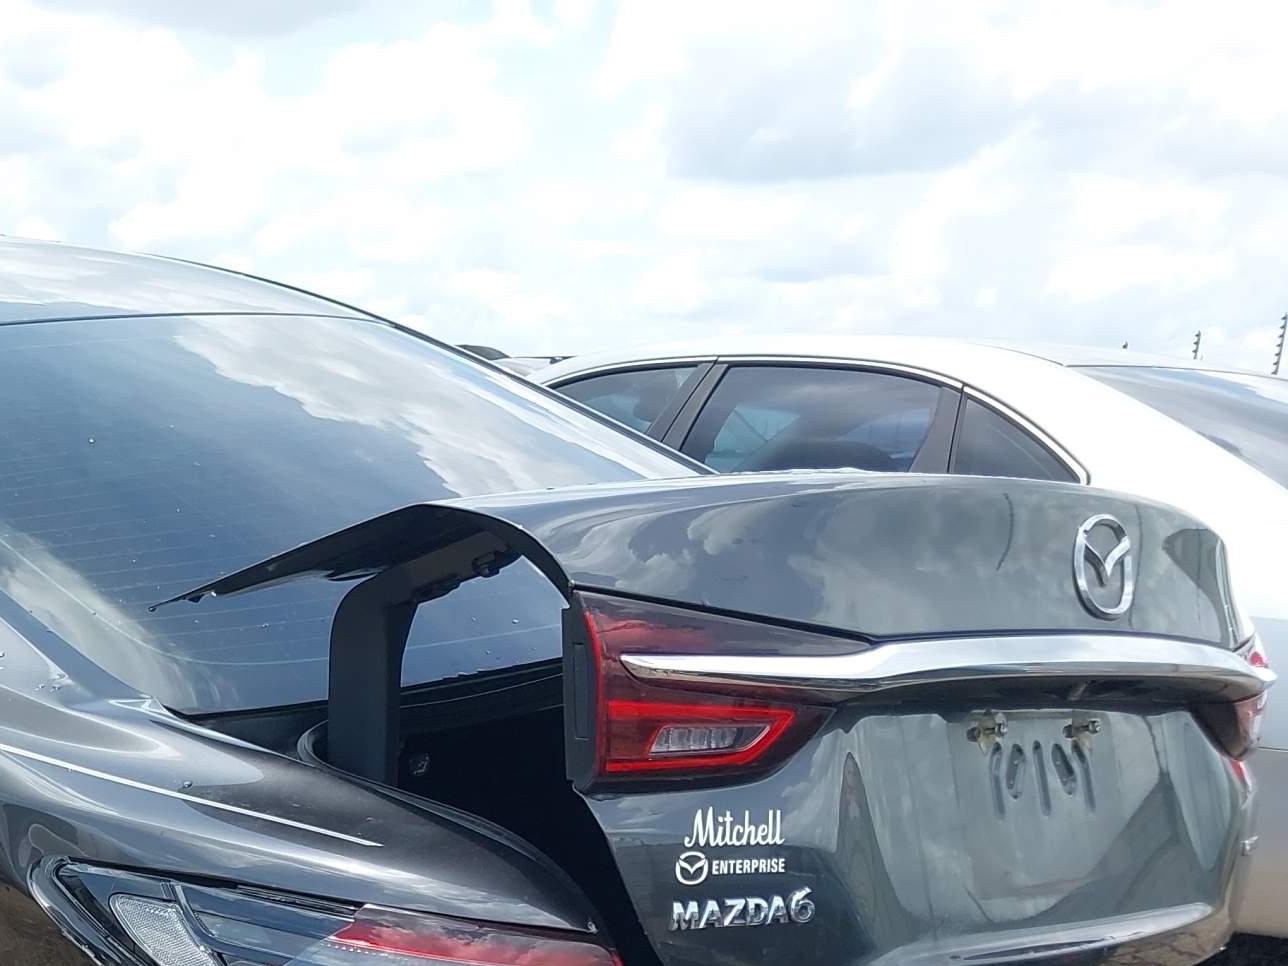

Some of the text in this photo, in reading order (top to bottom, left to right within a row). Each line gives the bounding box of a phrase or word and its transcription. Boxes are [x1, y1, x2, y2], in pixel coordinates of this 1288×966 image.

[684, 806, 785, 847] Mitchell
[712, 858, 785, 875] ENTERPRISE
[669, 886, 815, 931] MAZDA6
